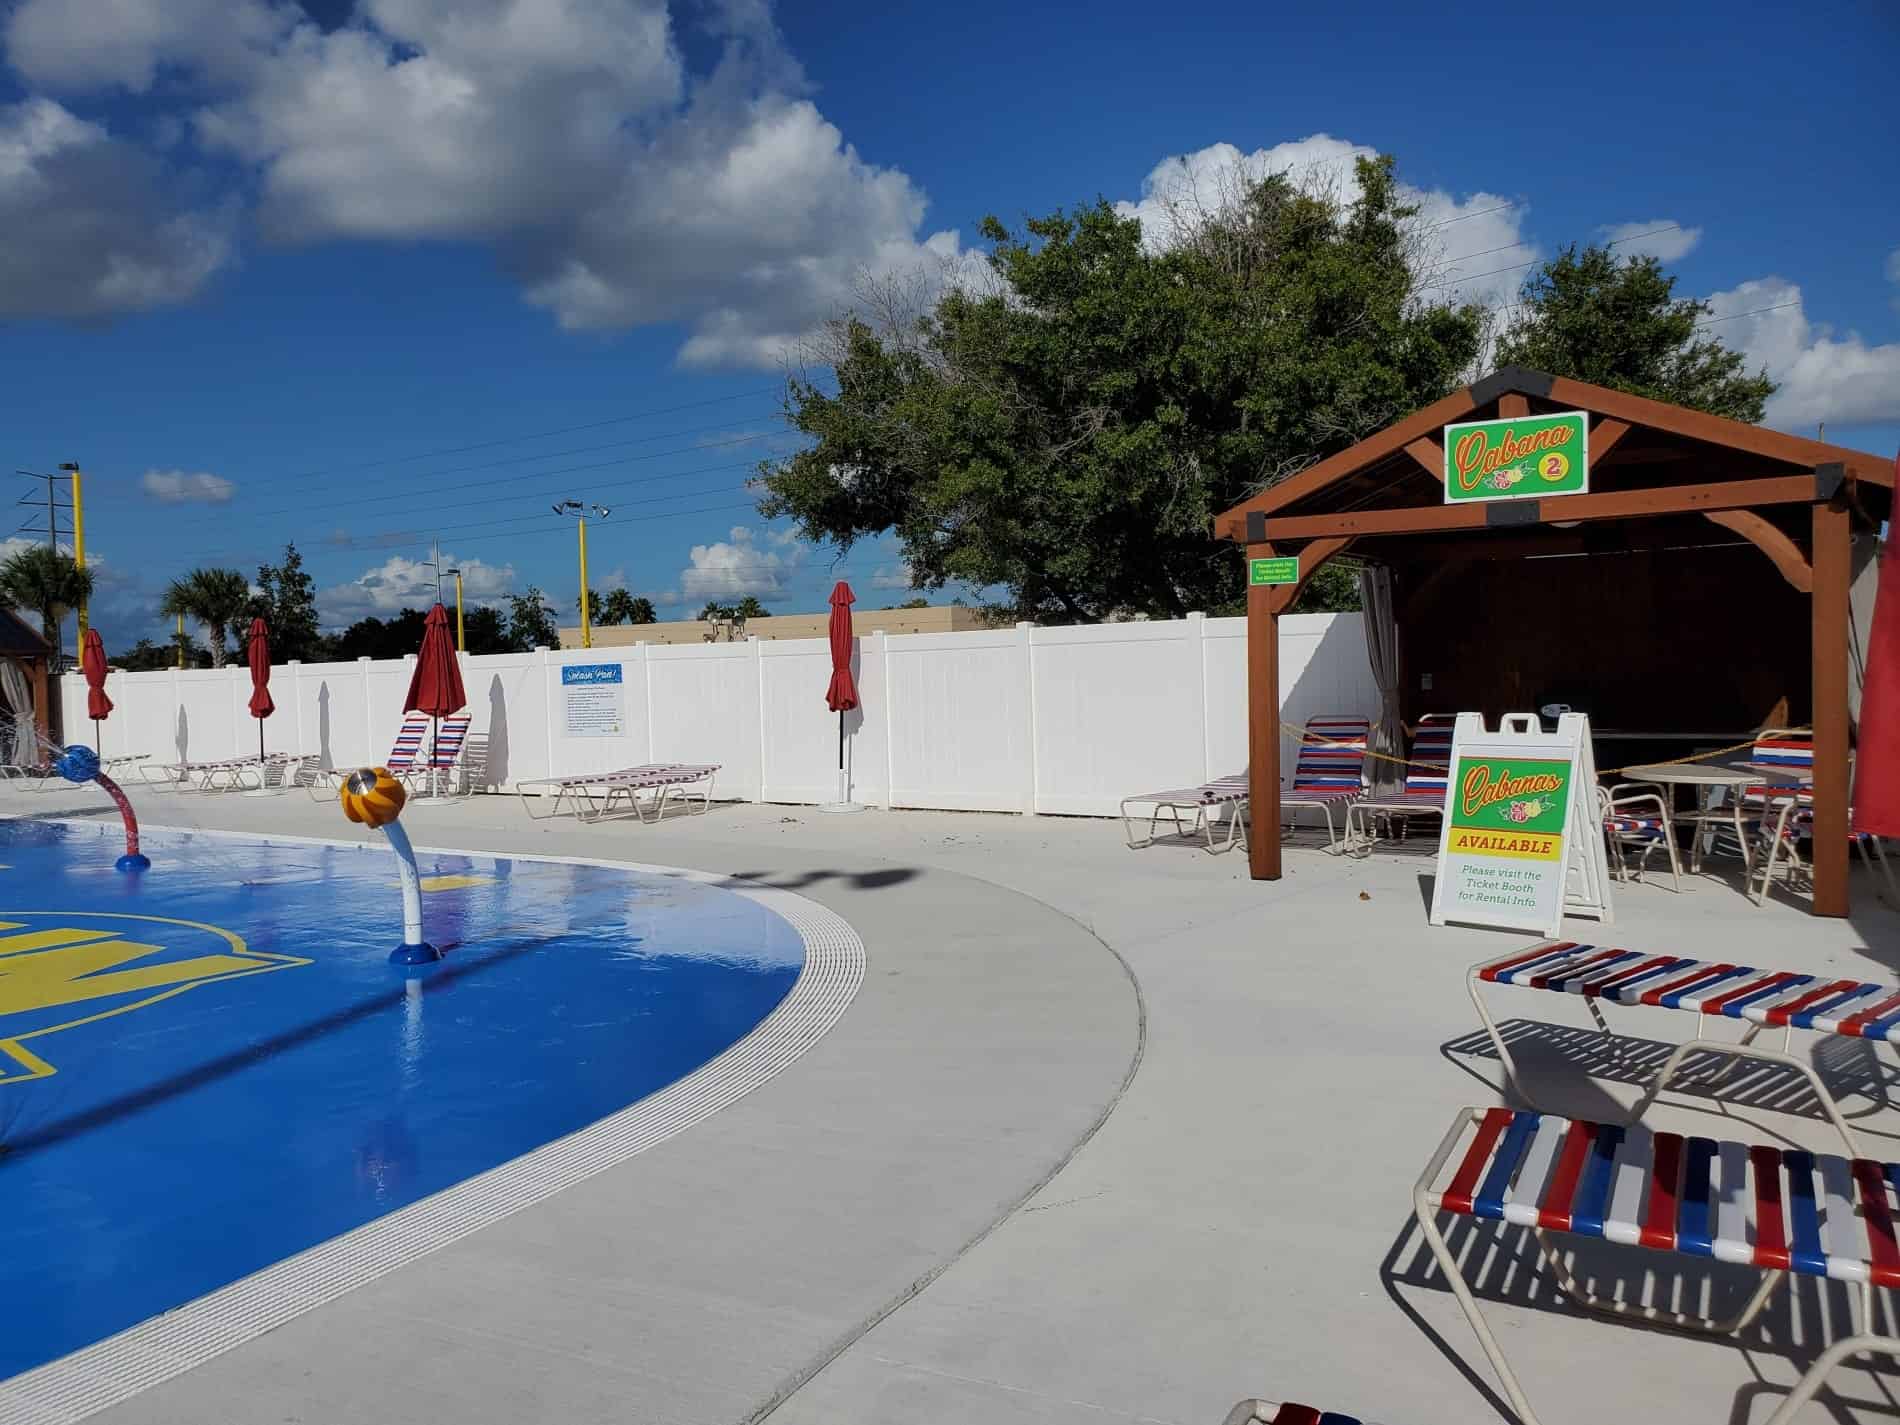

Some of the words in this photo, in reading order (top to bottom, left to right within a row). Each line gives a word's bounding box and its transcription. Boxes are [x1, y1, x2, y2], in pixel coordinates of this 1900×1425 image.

[1455, 425, 1574, 490] Cabana
[1546, 457, 1561, 476] 2
[1463, 765, 1563, 816] Cabanas
[1457, 835, 1552, 854] AVAILABLE
[1462, 864, 1496, 876] Please
[1498, 868, 1521, 879] visit
[1523, 871, 1542, 881] the
[1466, 878, 1499, 889] Ticket
[1502, 881, 1534, 893] Booth
[1458, 891, 1473, 901] for
[1476, 892, 1510, 905] Rental
